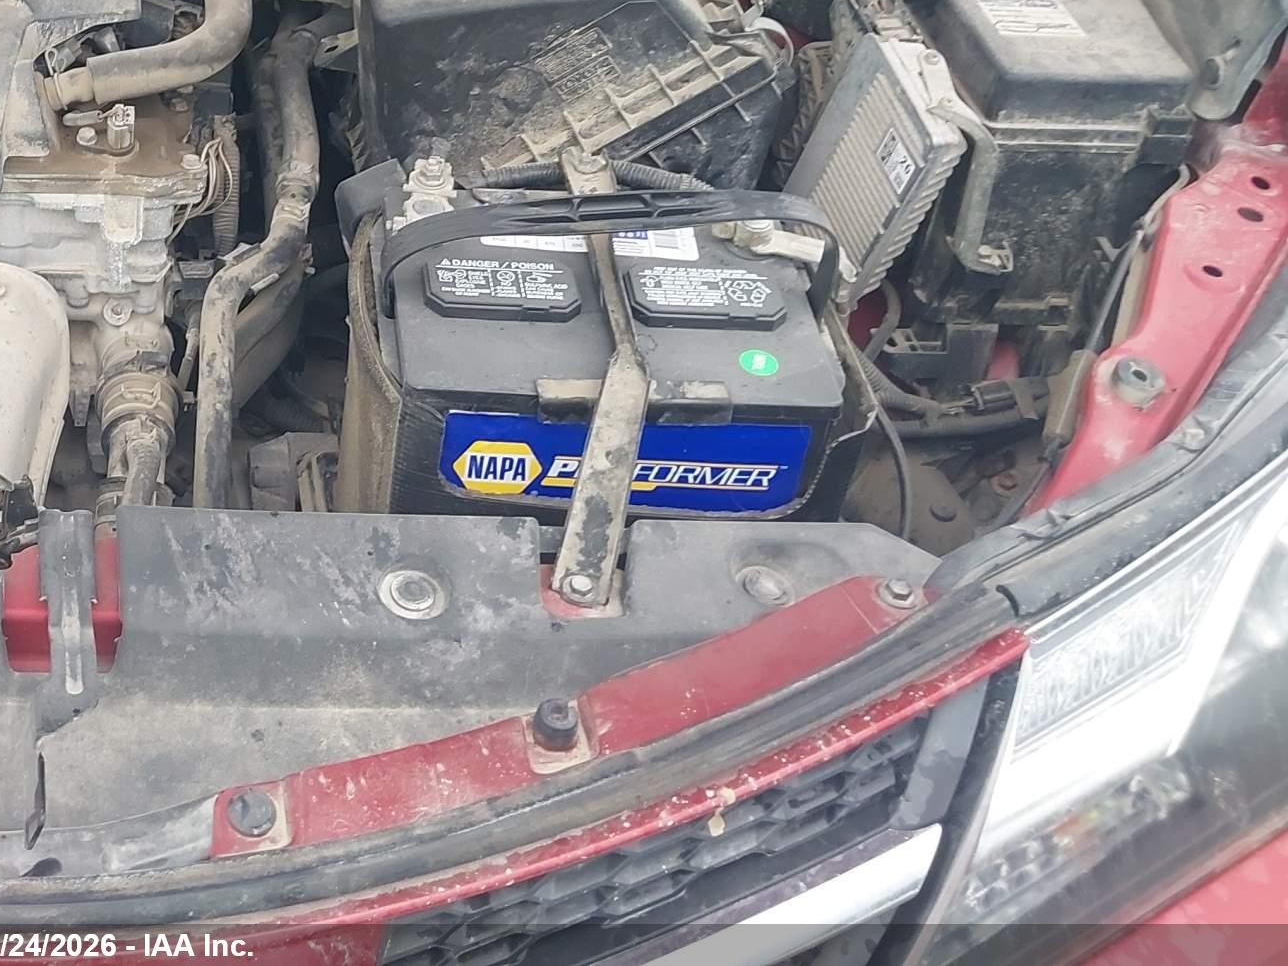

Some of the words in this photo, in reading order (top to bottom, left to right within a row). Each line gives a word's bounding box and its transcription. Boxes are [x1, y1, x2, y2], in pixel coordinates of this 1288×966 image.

[452, 259, 499, 268] DANGER
[511, 262, 554, 270] POISON
[467, 455, 527, 481] NAPA
[547, 460, 777, 487] PFORMER
